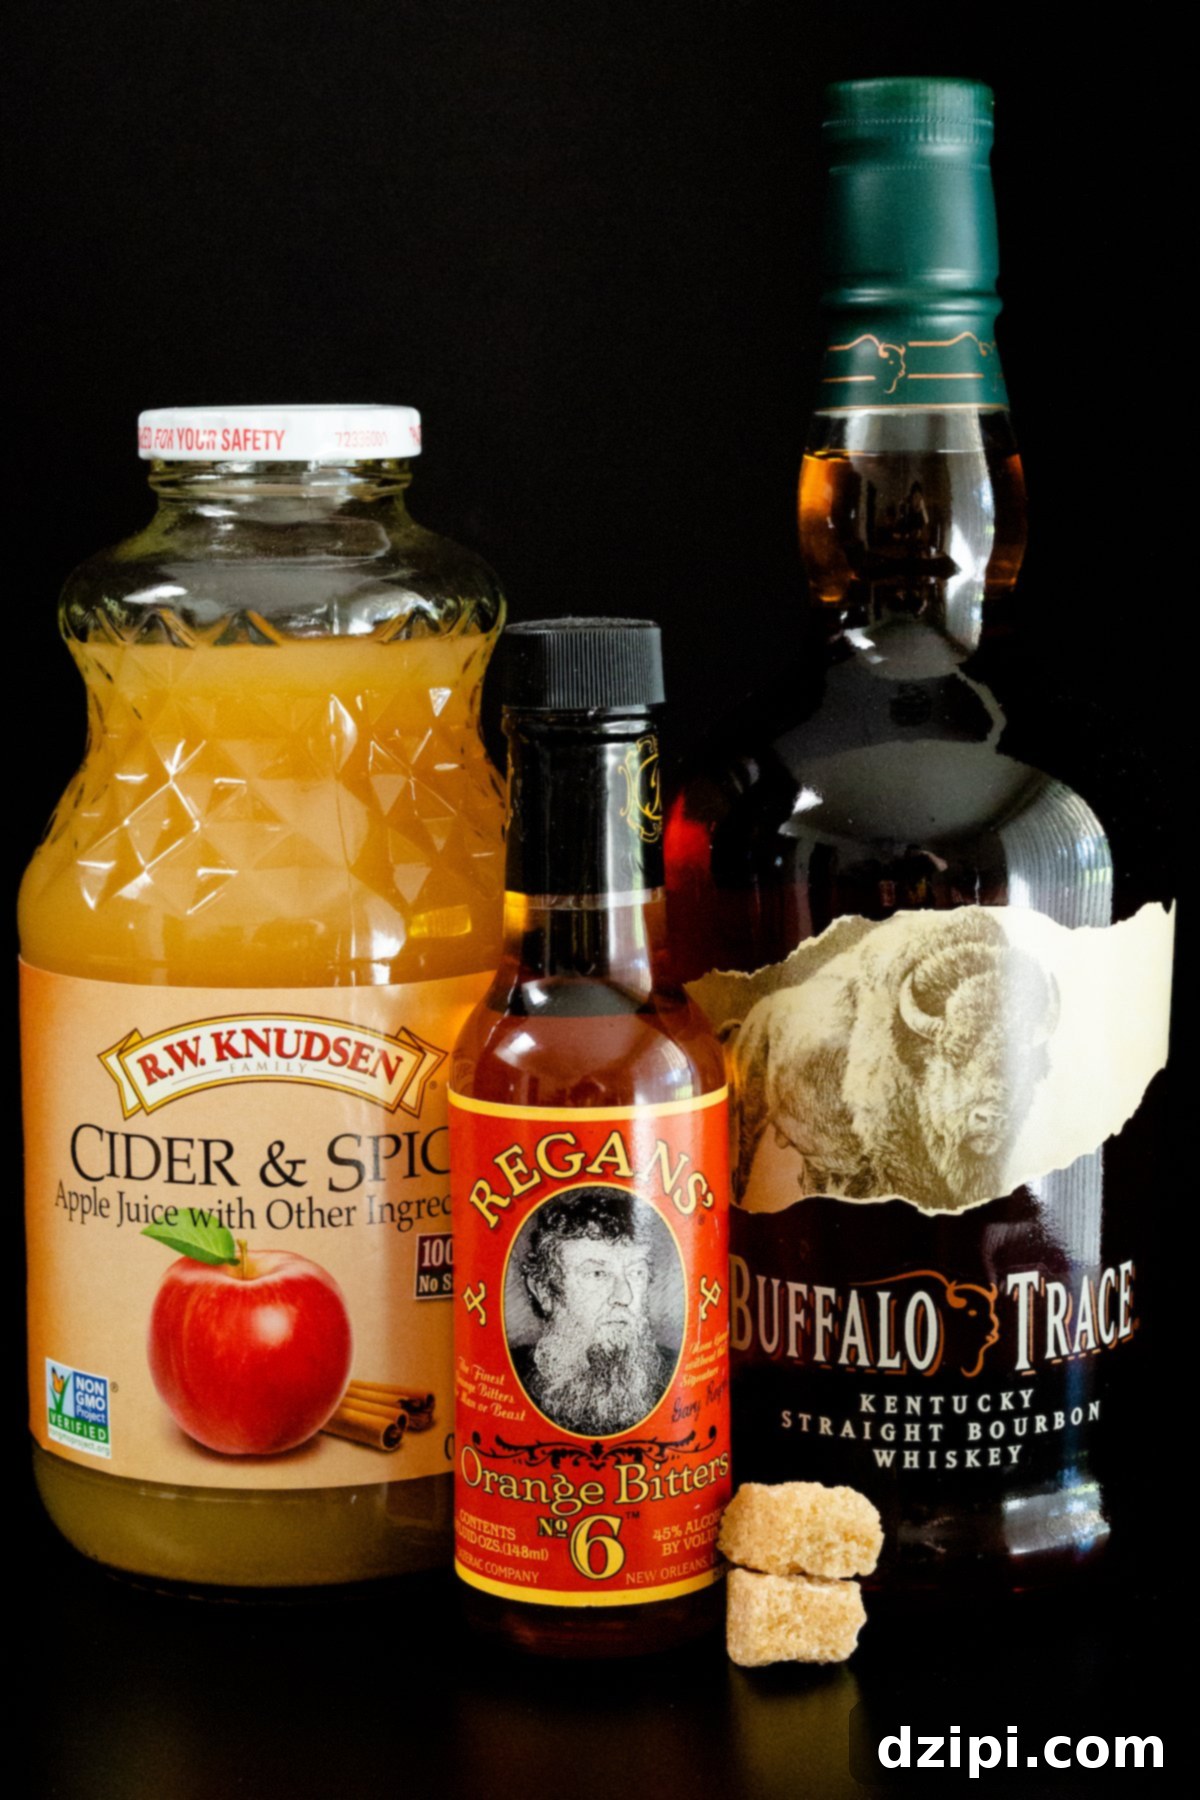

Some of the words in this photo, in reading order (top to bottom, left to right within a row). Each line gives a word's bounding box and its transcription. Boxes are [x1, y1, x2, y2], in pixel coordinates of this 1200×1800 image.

[154, 428, 174, 449] FOR
[176, 427, 217, 450] YOUR
[221, 428, 286, 451] SAFETY
[136, 1035, 205, 1087] R.W.
[214, 1027, 404, 1085] KNUDSEN
[229, 1060, 309, 1074] FAMILY
[70, 1123, 240, 1187] CIDER
[259, 1139, 309, 1188] &
[54, 1178, 111, 1225] Apple
[116, 1190, 179, 1227] Juice
[187, 1196, 256, 1230] with
[265, 1196, 357, 1230] Other
[418, 1274, 438, 1293] No
[729, 1254, 941, 1373] BUFFALO
[1006, 1260, 1134, 1373] TRACE
[75, 1375, 105, 1396] NON
[75, 1391, 106, 1411] GMO
[860, 1388, 1035, 1416] KENTUCKY
[49, 1411, 107, 1441] VERIFIED
[781, 1410, 944, 1443] STRAIGHT
[967, 1400, 1101, 1442] BOURBON
[872, 1445, 1022, 1470] WHISKEY
[460, 1446, 605, 1516] Orange
[613, 1452, 729, 1505] Bitters
[459, 1508, 516, 1541] CONTENTS
[652, 1525, 683, 1542] 45%
[570, 1514, 625, 1580] 6
[661, 1539, 681, 1557] BY
[484, 1561, 540, 1584] COMPANY
[625, 1569, 657, 1585] NEW
